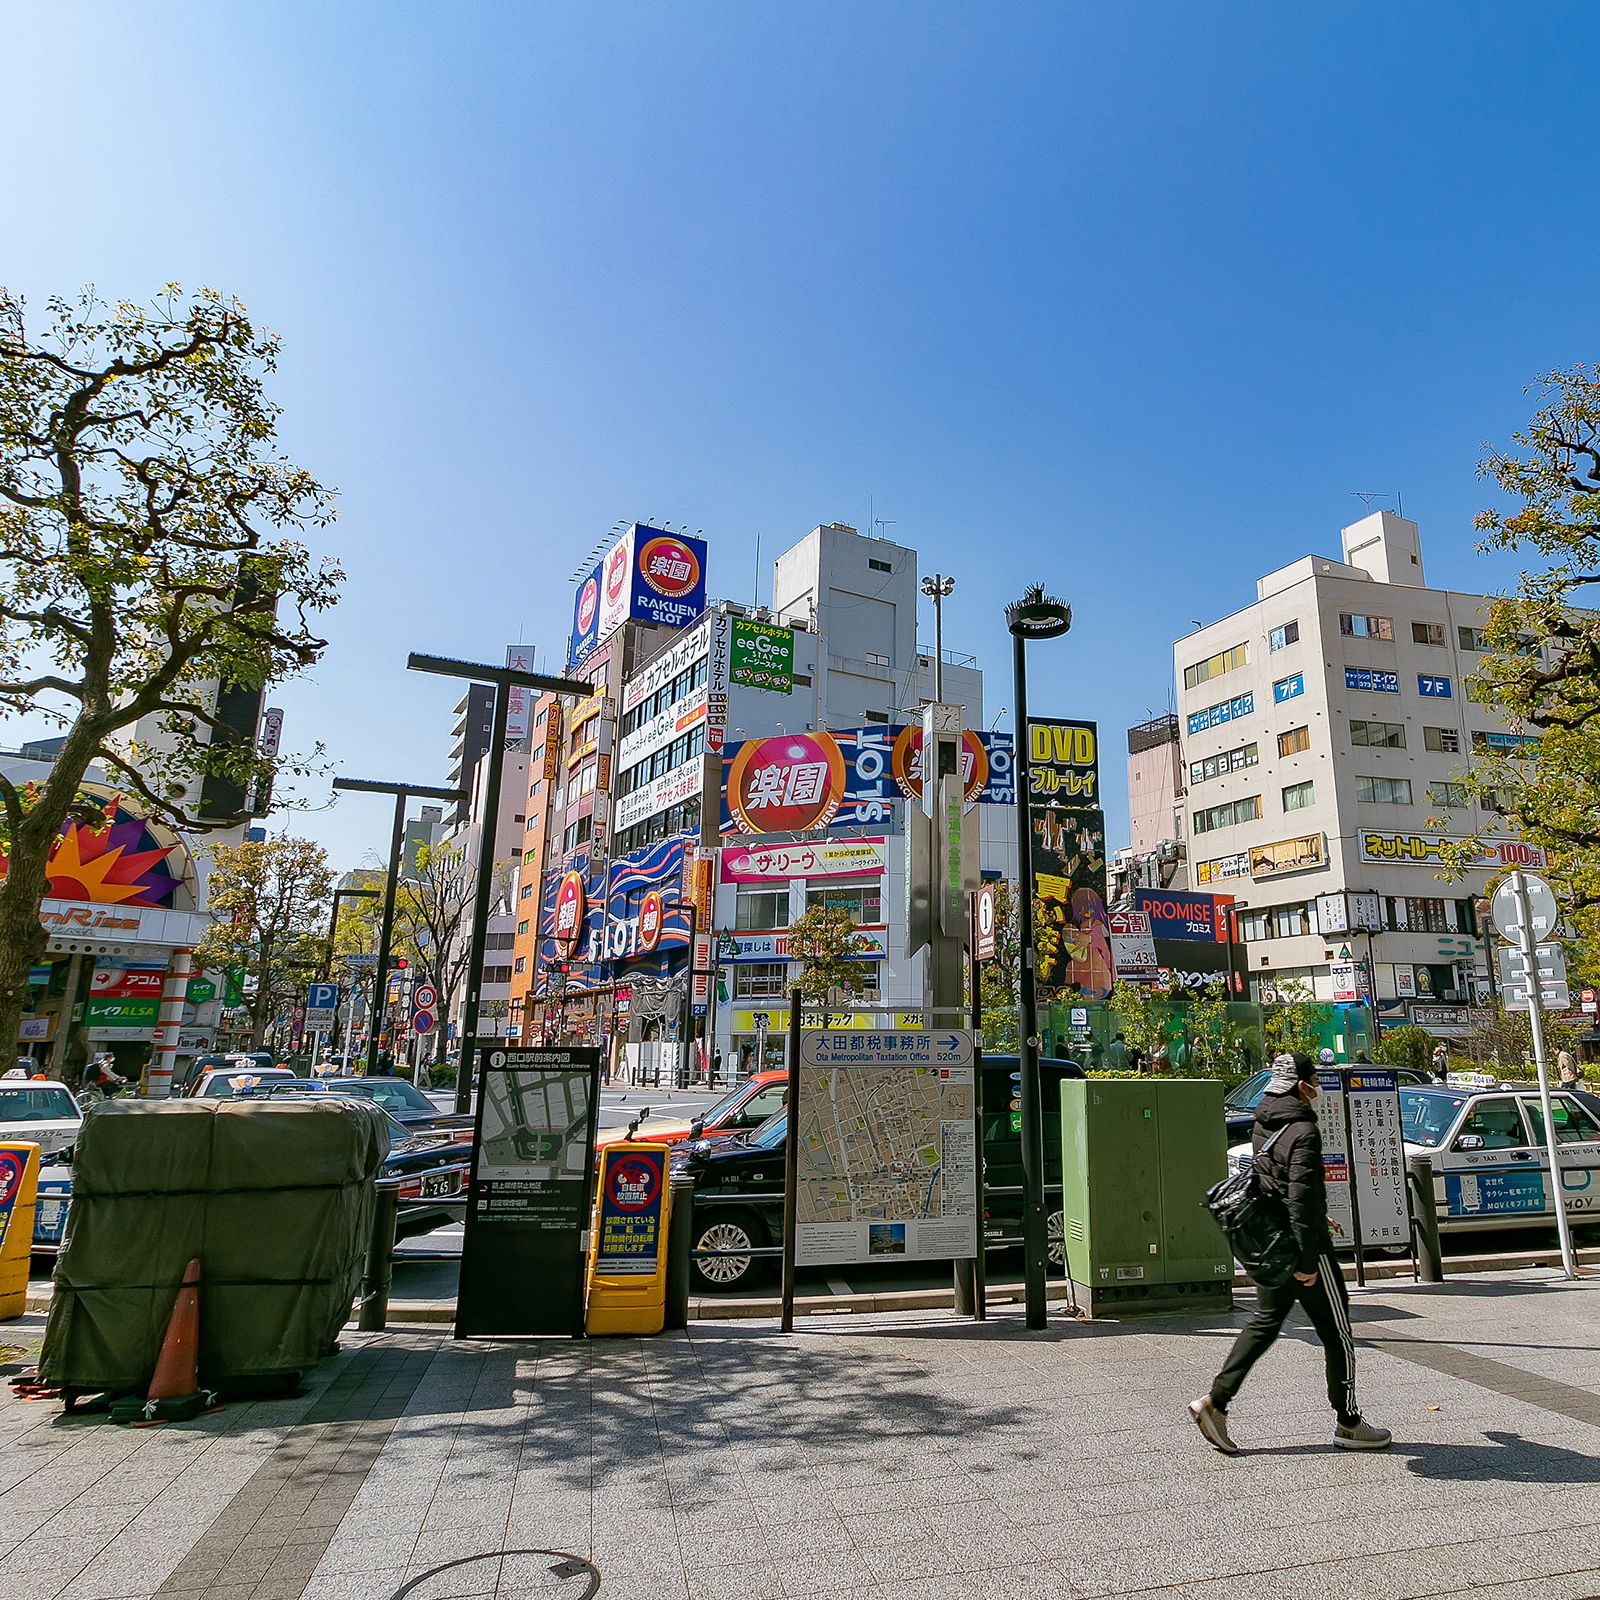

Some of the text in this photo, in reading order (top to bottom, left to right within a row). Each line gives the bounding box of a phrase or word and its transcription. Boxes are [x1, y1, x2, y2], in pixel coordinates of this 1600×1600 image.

[649, 555, 692, 582] 楽園
[640, 570, 697, 599] EXCITING AMUSEMENT
[637, 595, 697, 618] RAKUEN
[652, 610, 682, 625] SLOT
[736, 620, 791, 640] カプセルホテル
[712, 616, 727, 692] カプセルホテル
[737, 635, 790, 657] eeGee
[646, 628, 709, 693] カプセルホテル
[742, 656, 783, 671] イージーステイ
[752, 650, 774, 661] STAY
[1373, 674, 1397, 684] エイワ
[1423, 680, 1444, 693] 7F
[1279, 683, 1299, 699] 7F
[1221, 696, 1252, 715] エイワ
[648, 715, 675, 744] eeGee
[1031, 725, 1096, 767] DVD
[989, 734, 1012, 804] SLOT
[1205, 757, 1228, 777] 全日
[855, 729, 885, 823] SLOT
[1031, 767, 1095, 797] ブルーレイ
[745, 761, 829, 811] 楽園
[1365, 834, 1455, 860] ネットルー
[1497, 843, 1542, 865] 100円
[756, 850, 816, 873] ザ・リーヴ
[1142, 899, 1211, 922] PROMISE
[1110, 913, 1150, 934] 今割
[1186, 922, 1212, 934] プロミス
[588, 917, 640, 962] SLOT
[126, 974, 161, 986] アコム
[315, 986, 332, 1007] P
[420, 993, 432, 1003] 30
[694, 1005, 706, 1014] 2F
[815, 1035, 931, 1051] 大田都税事務所
[507, 1053, 571, 1063] 西口駅前案内図
[815, 1052, 829, 1061] Ota
[830, 1052, 874, 1063] Metropolitan
[909, 1052, 930, 1062] Office
[936, 1052, 961, 1062] 520m
[1362, 1077, 1394, 1088] 駐輪禁止
[1385, 1098, 1404, 1217] チェーン等で施錠している
[1482, 1155, 1498, 1163] TAXI
[621, 1183, 645, 1192] 自転車
[1484, 1178, 1504, 1186] 次世代
[616, 1192, 648, 1201] 放置禁止
[1564, 1197, 1594, 1209] MOV
[606, 1216, 656, 1225] 放置されている
[604, 1234, 654, 1244] 原動機付自転車
[1370, 1226, 1402, 1238] 大田区
[603, 1244, 646, 1253] は撤去します
[1213, 1264, 1228, 1274] HS
